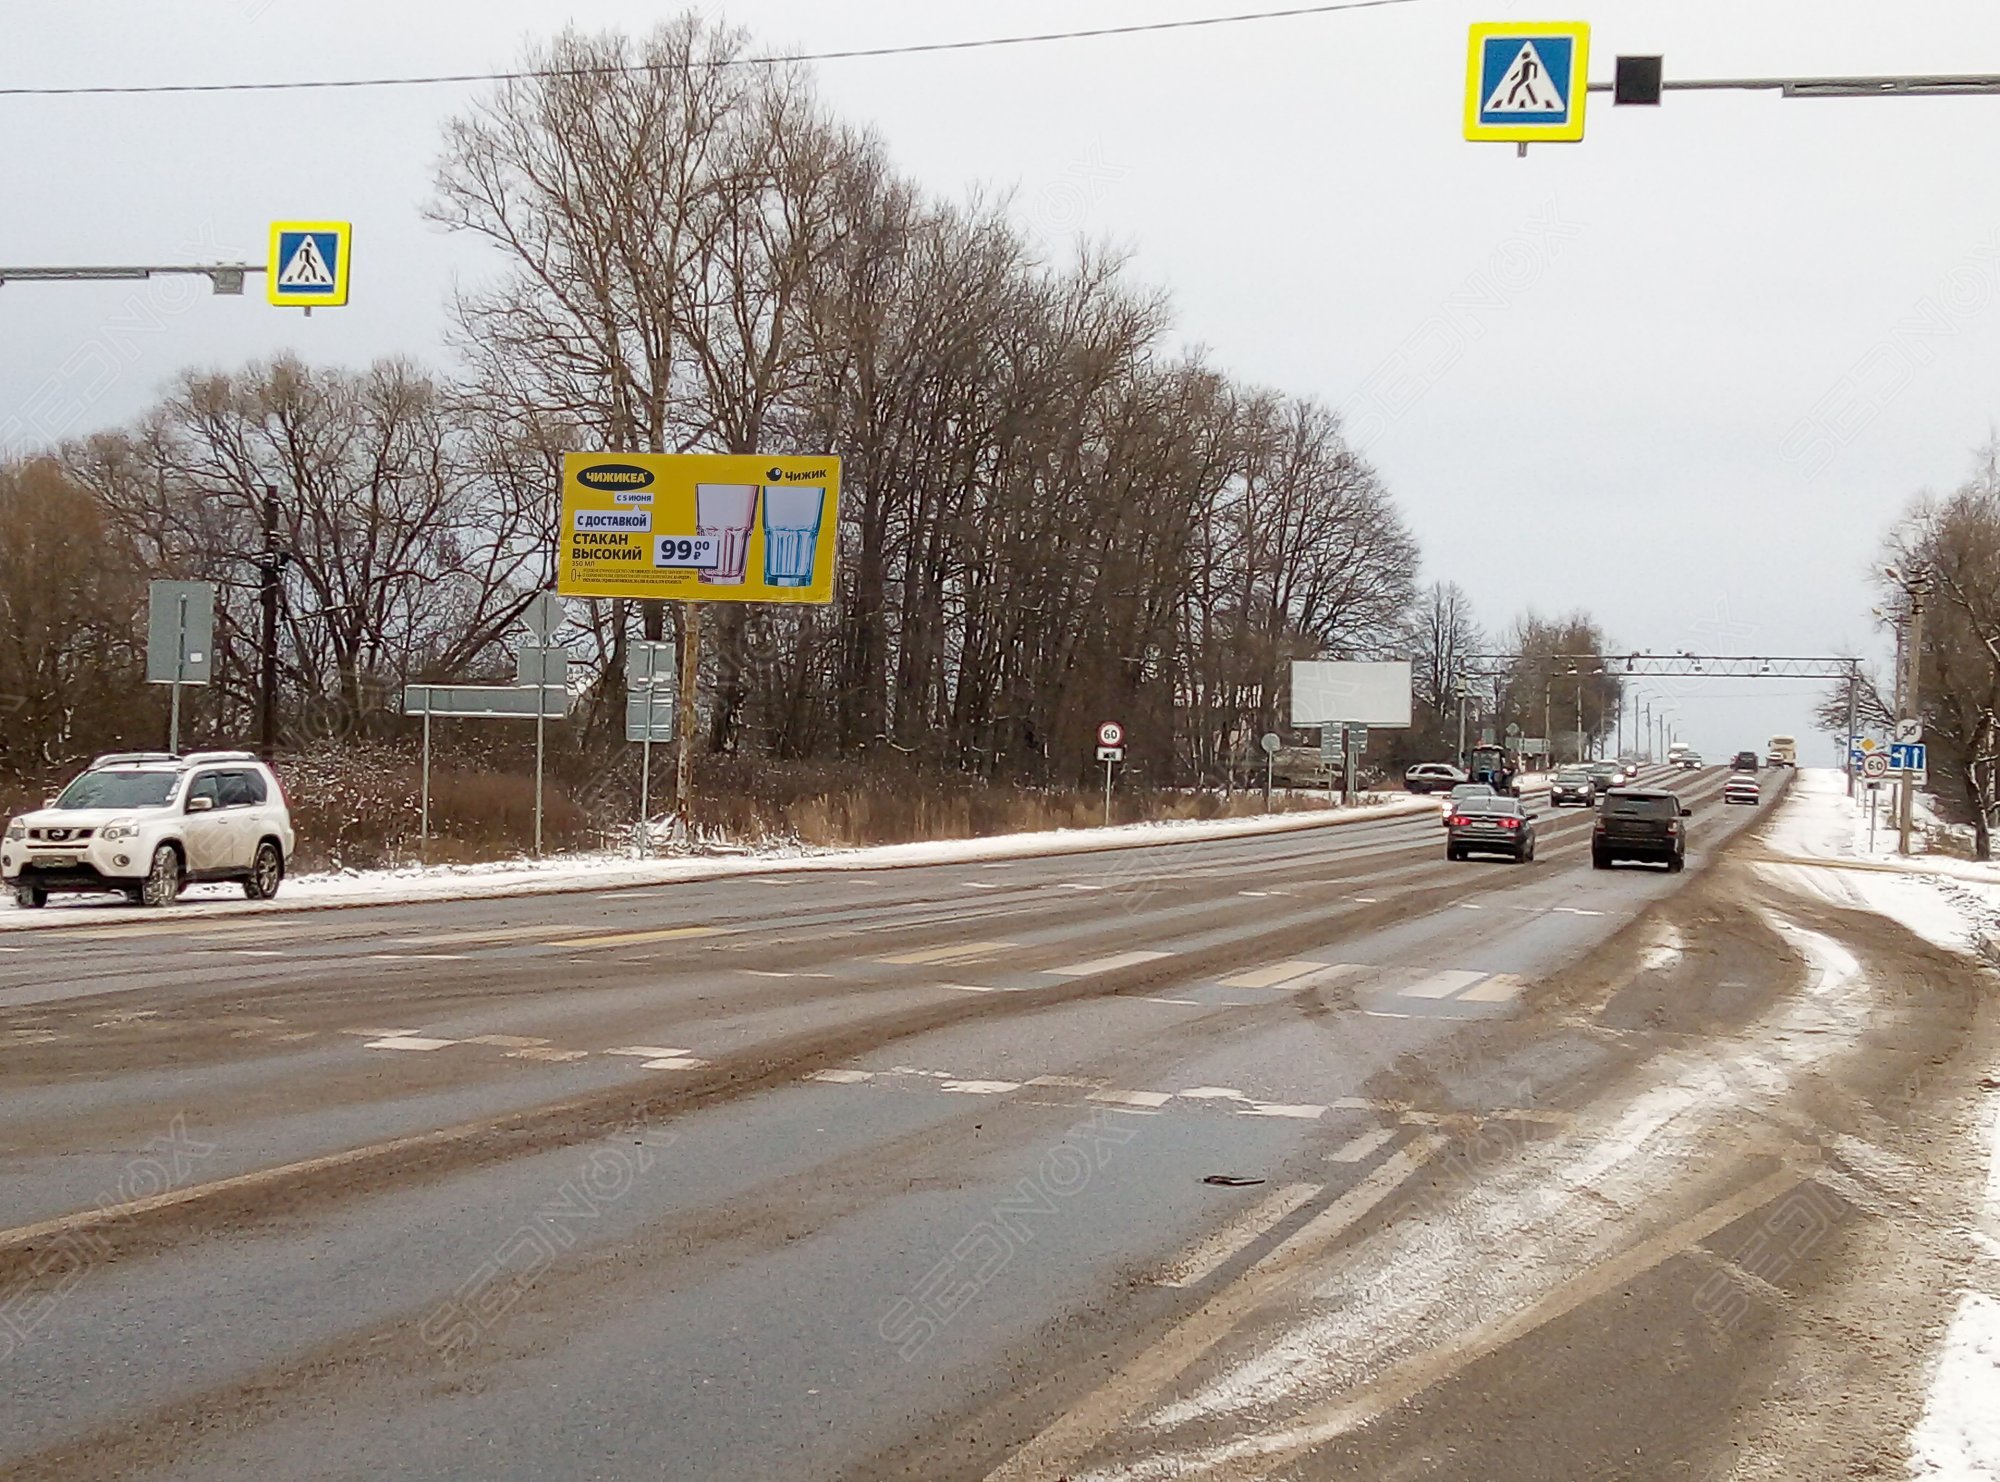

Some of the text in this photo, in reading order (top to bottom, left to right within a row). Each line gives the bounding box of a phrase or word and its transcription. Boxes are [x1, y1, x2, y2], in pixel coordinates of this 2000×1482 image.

[616, 494, 622, 502] С
[577, 514, 647, 528] С ДОСТАВКОЙ
[572, 533, 629, 546] СТАКАН
[571, 545, 642, 561] ВЫСОКИЙ
[570, 568, 582, 583] 0+
[1103, 729, 1118, 740] 60
[1867, 760, 1884, 771] 60
